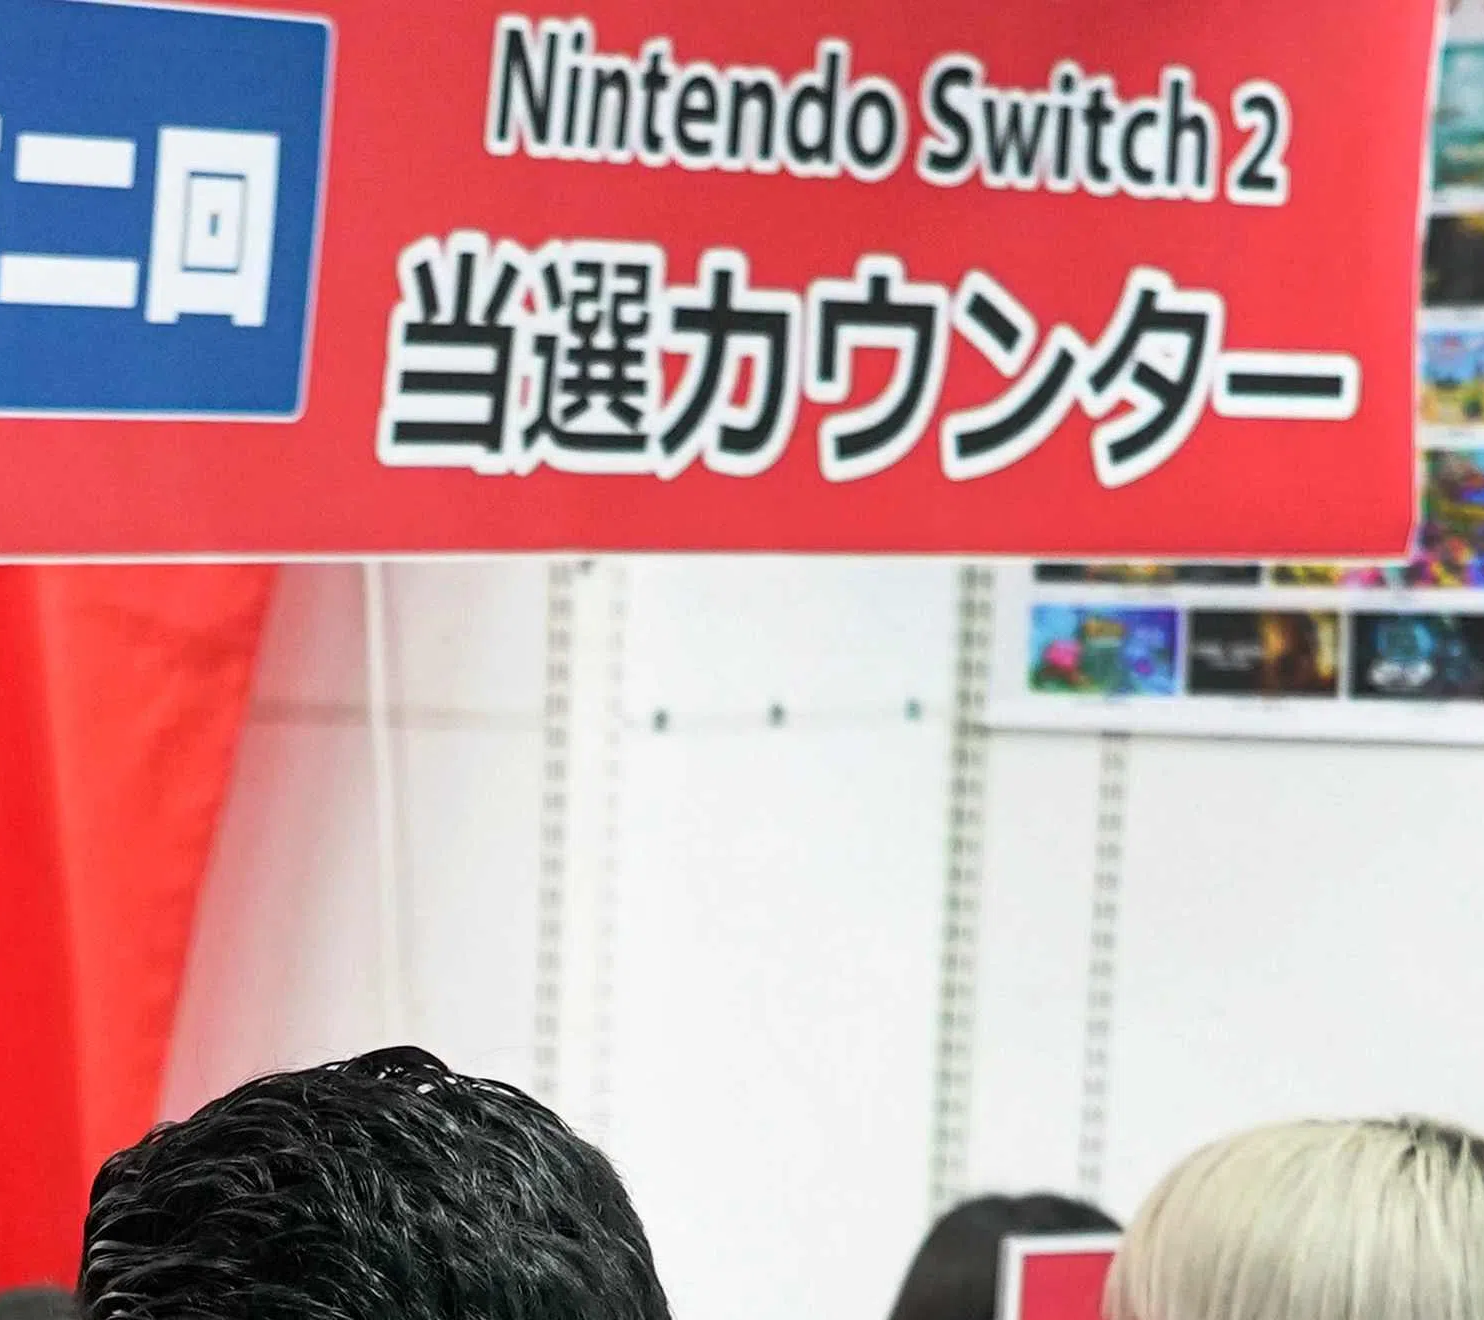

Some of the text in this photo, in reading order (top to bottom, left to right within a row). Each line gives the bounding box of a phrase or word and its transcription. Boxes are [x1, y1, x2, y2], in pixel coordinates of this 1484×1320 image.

[491, 18, 1289, 206] Nintendo Switch 2
[382, 235, 1355, 485] 当選カウンター
